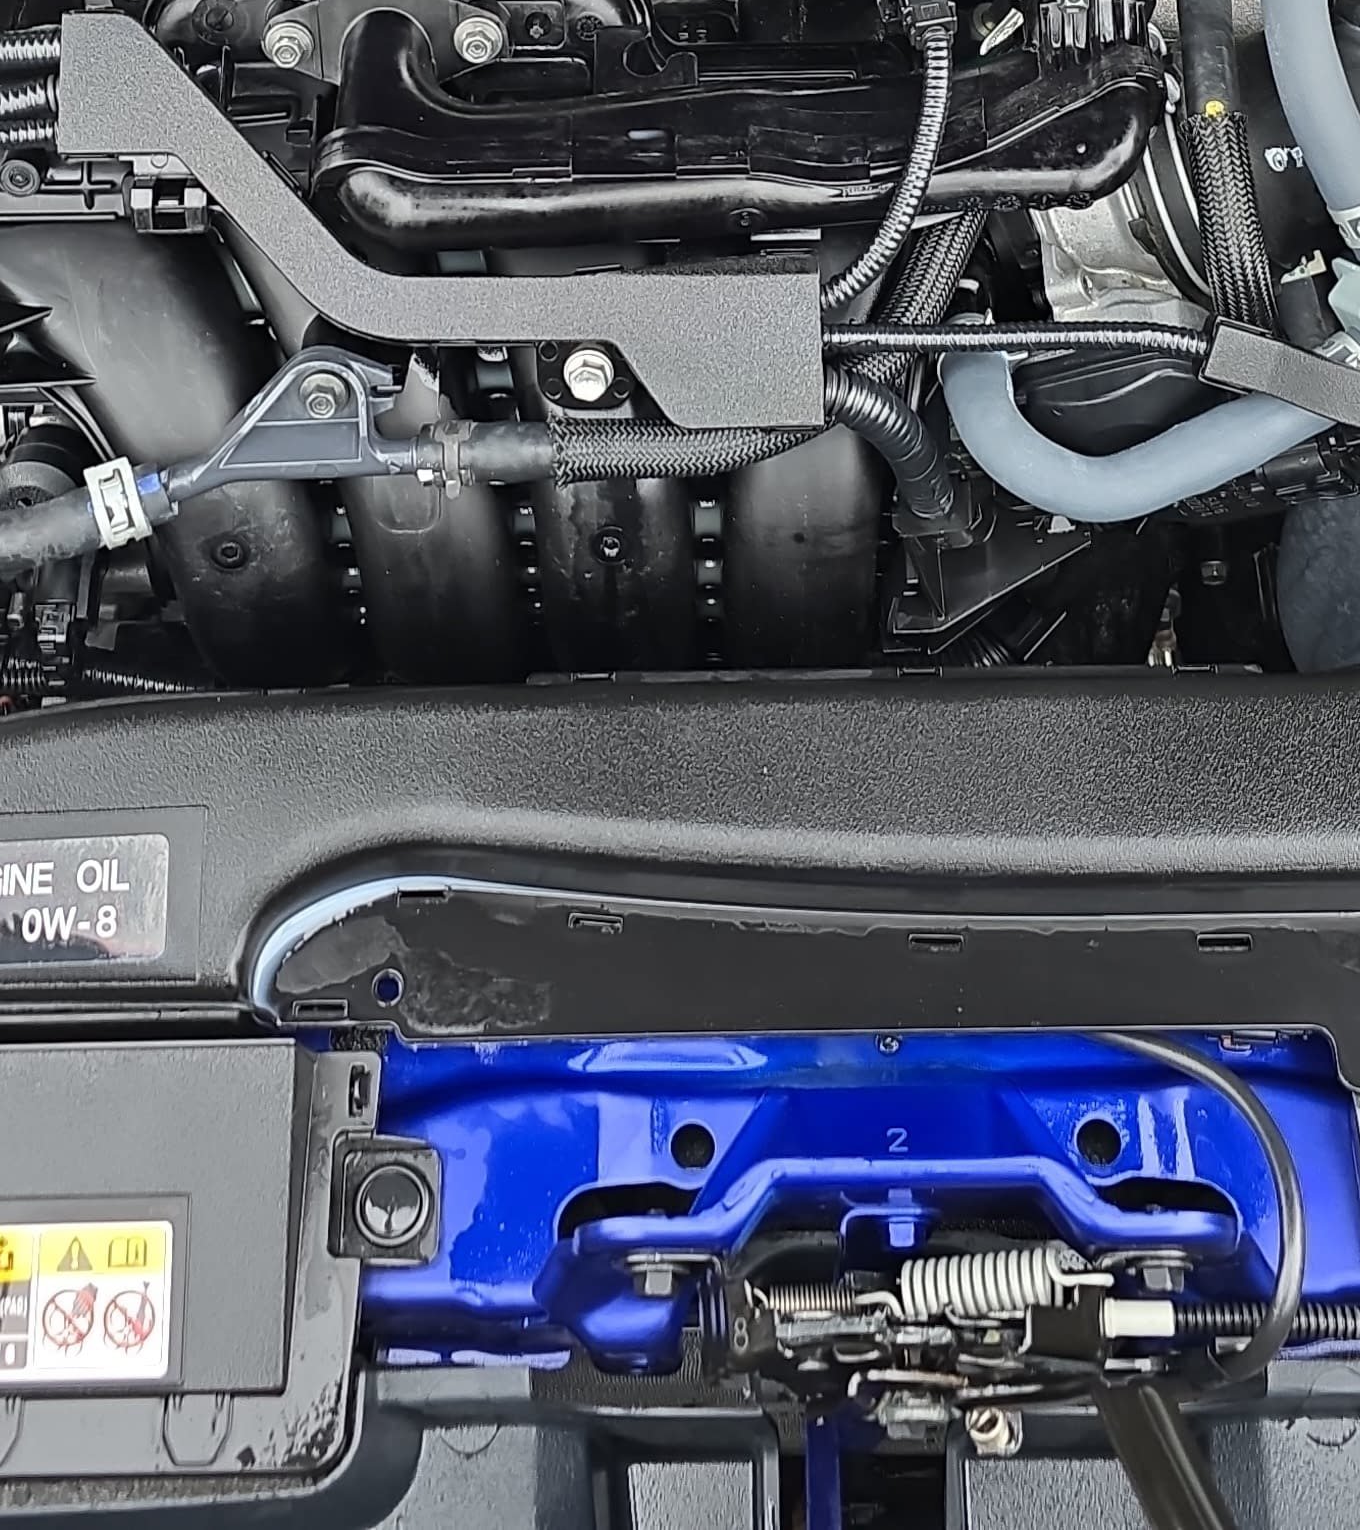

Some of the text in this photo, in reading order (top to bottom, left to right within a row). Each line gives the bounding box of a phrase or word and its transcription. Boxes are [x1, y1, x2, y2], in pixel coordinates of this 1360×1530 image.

[77, 858, 130, 894] OIL
[22, 904, 118, 944] 0W-8
[886, 1127, 909, 1153] 2
